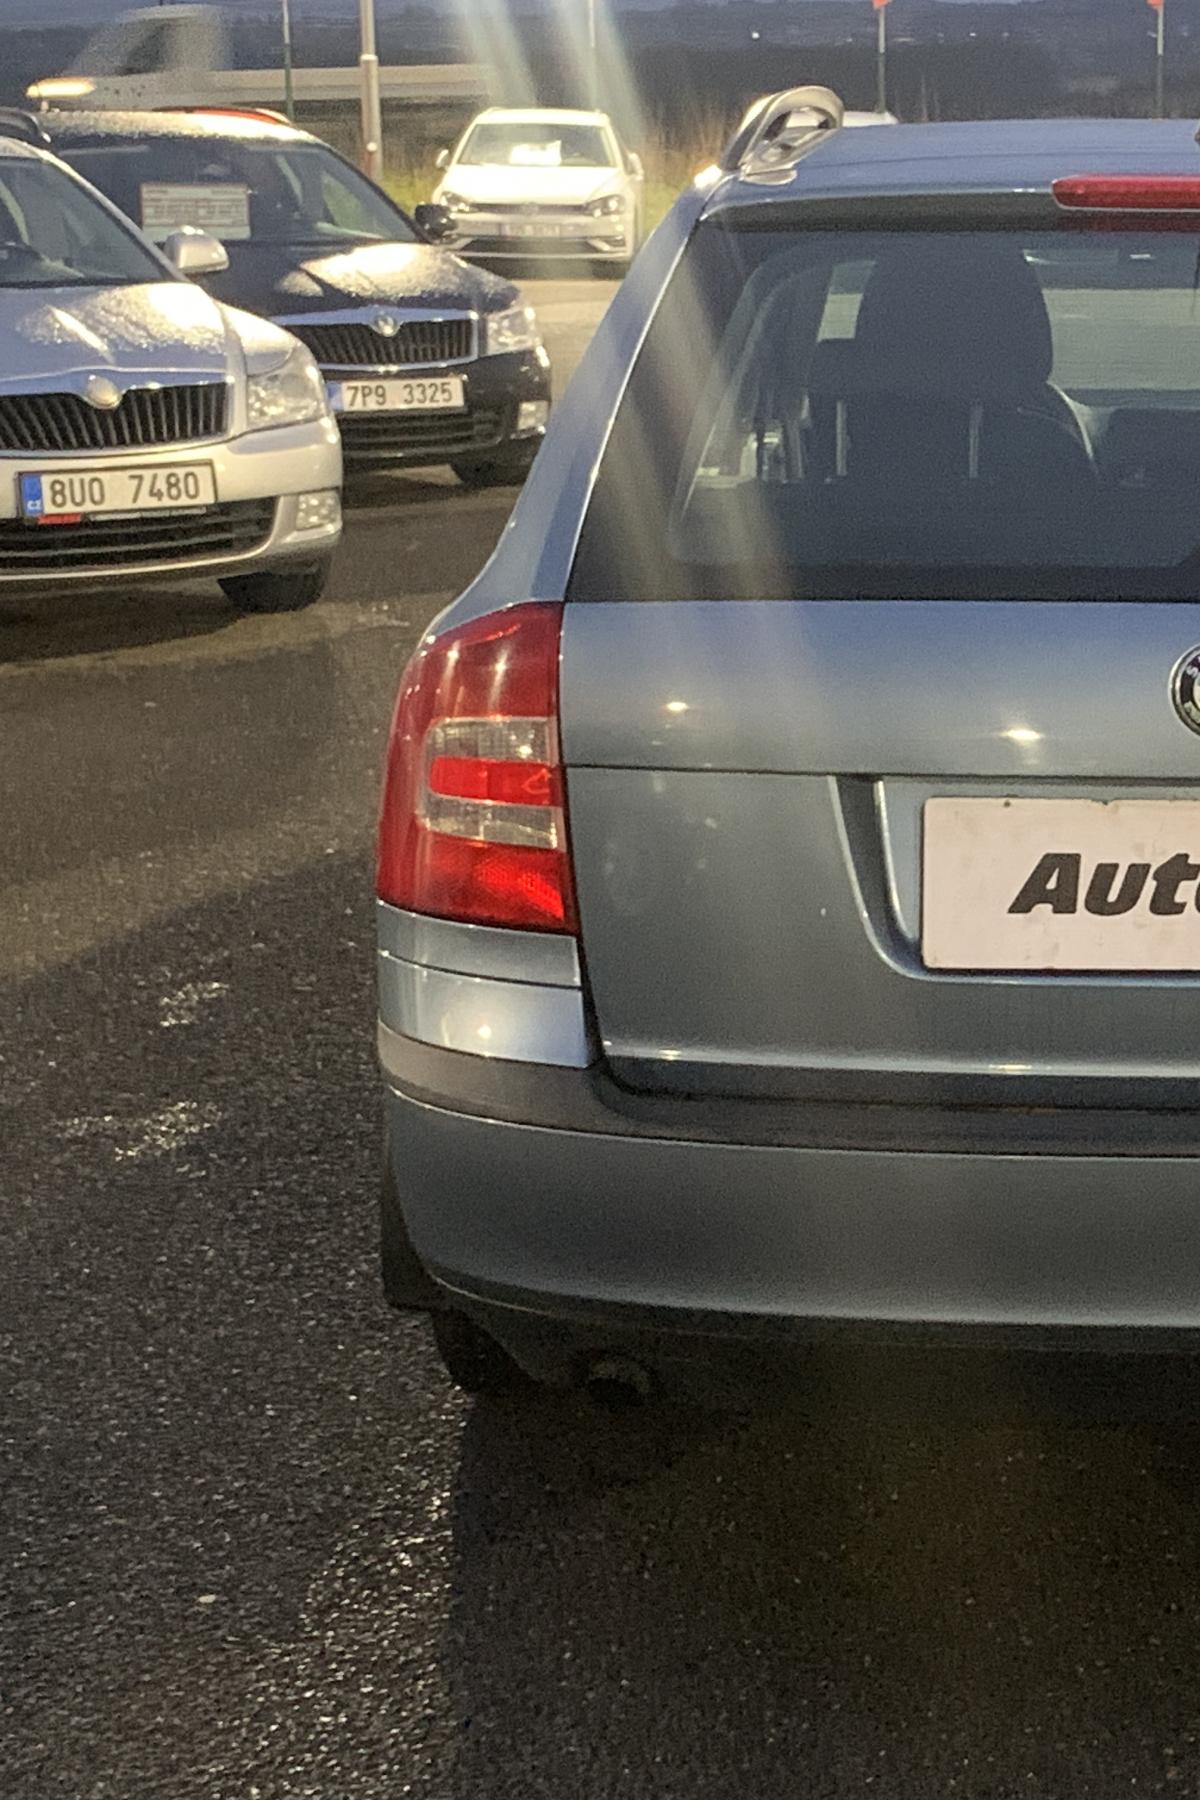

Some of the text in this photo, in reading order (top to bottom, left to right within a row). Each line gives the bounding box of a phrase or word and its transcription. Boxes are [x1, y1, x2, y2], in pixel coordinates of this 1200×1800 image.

[347, 382, 453, 407] 7P9 3325
[50, 471, 200, 508] 8U0 7480
